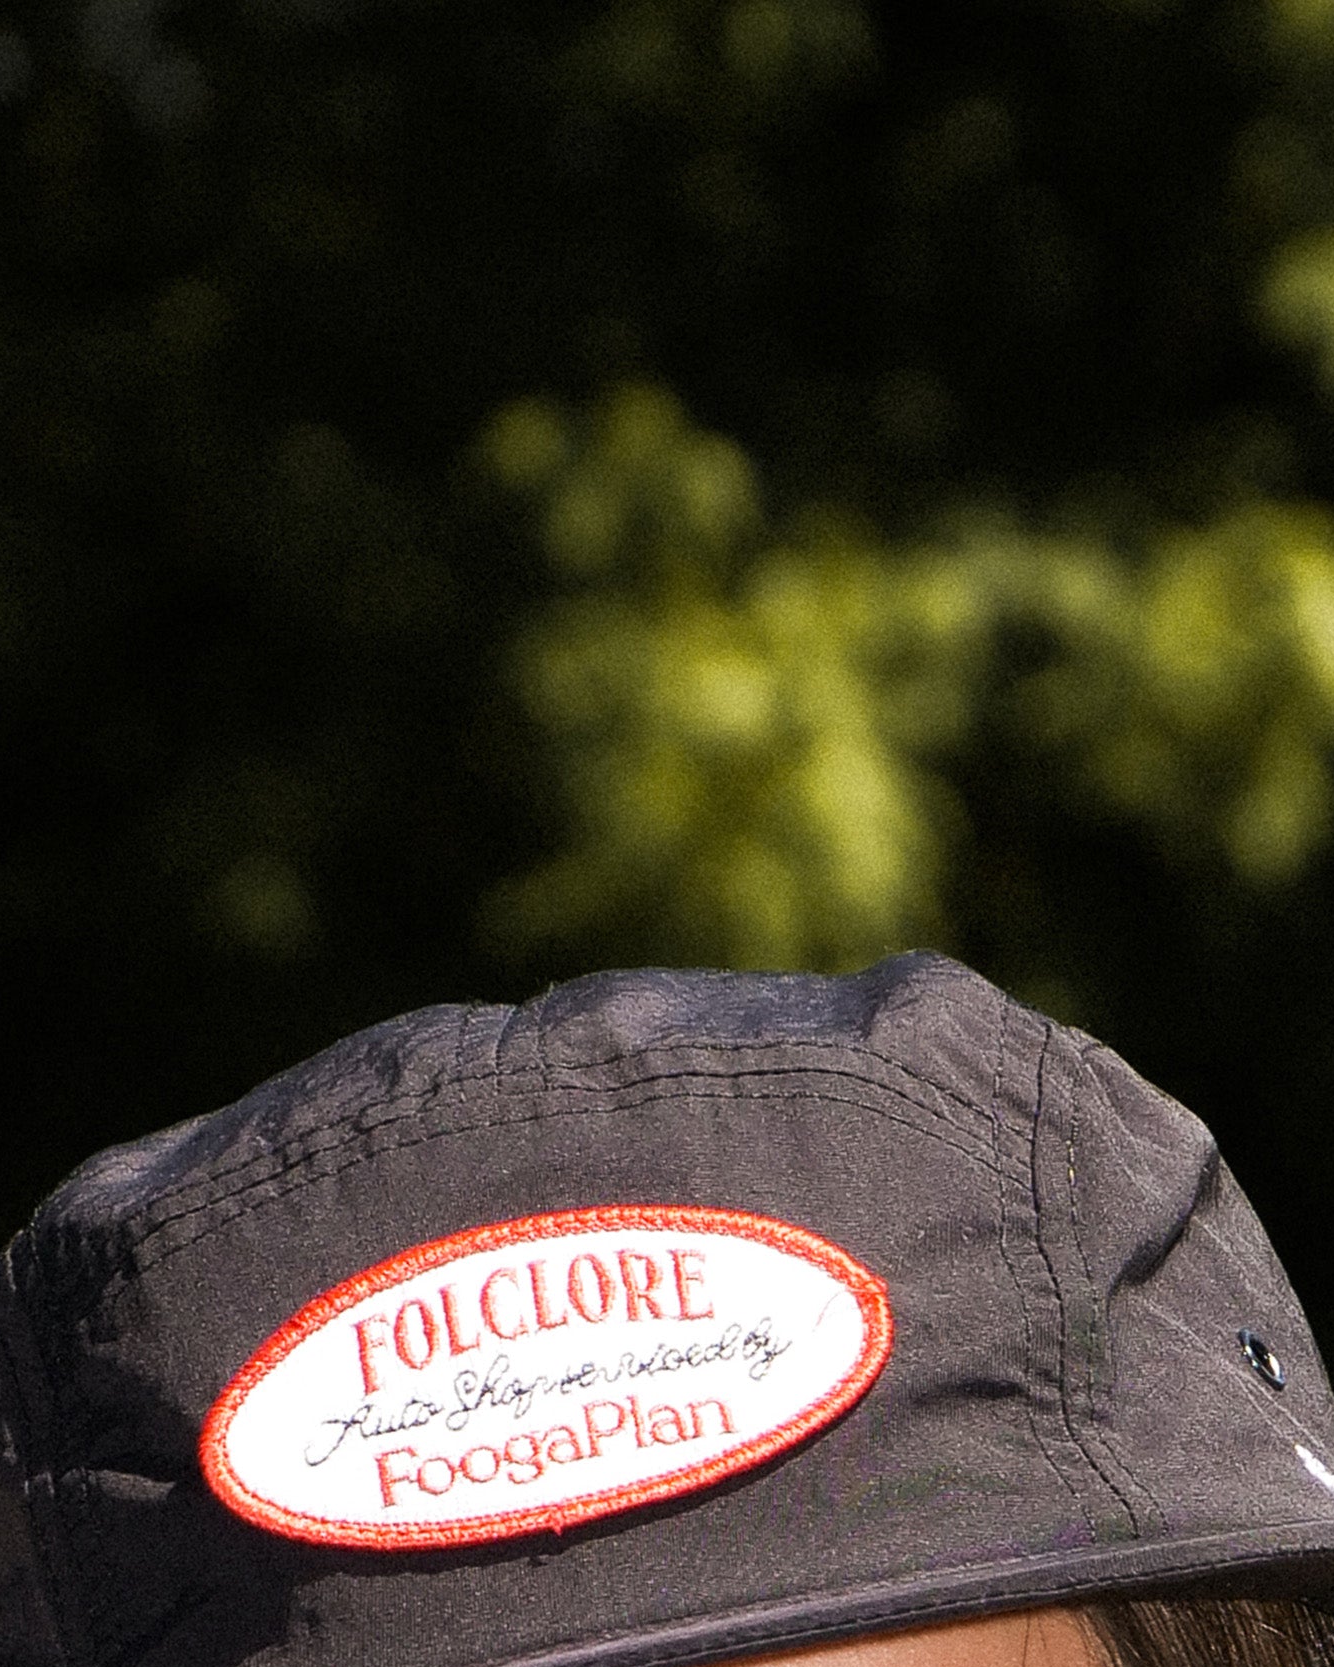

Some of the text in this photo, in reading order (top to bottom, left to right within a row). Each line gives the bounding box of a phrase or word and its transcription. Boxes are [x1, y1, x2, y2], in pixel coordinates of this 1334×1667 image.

[303, 1401, 445, 1467] Auto
[445, 1353, 557, 1432] Shop
[742, 1316, 794, 1381] by
[352, 1247, 715, 1397] FOLCLORE
[373, 1394, 738, 1508] FoogaPlan
